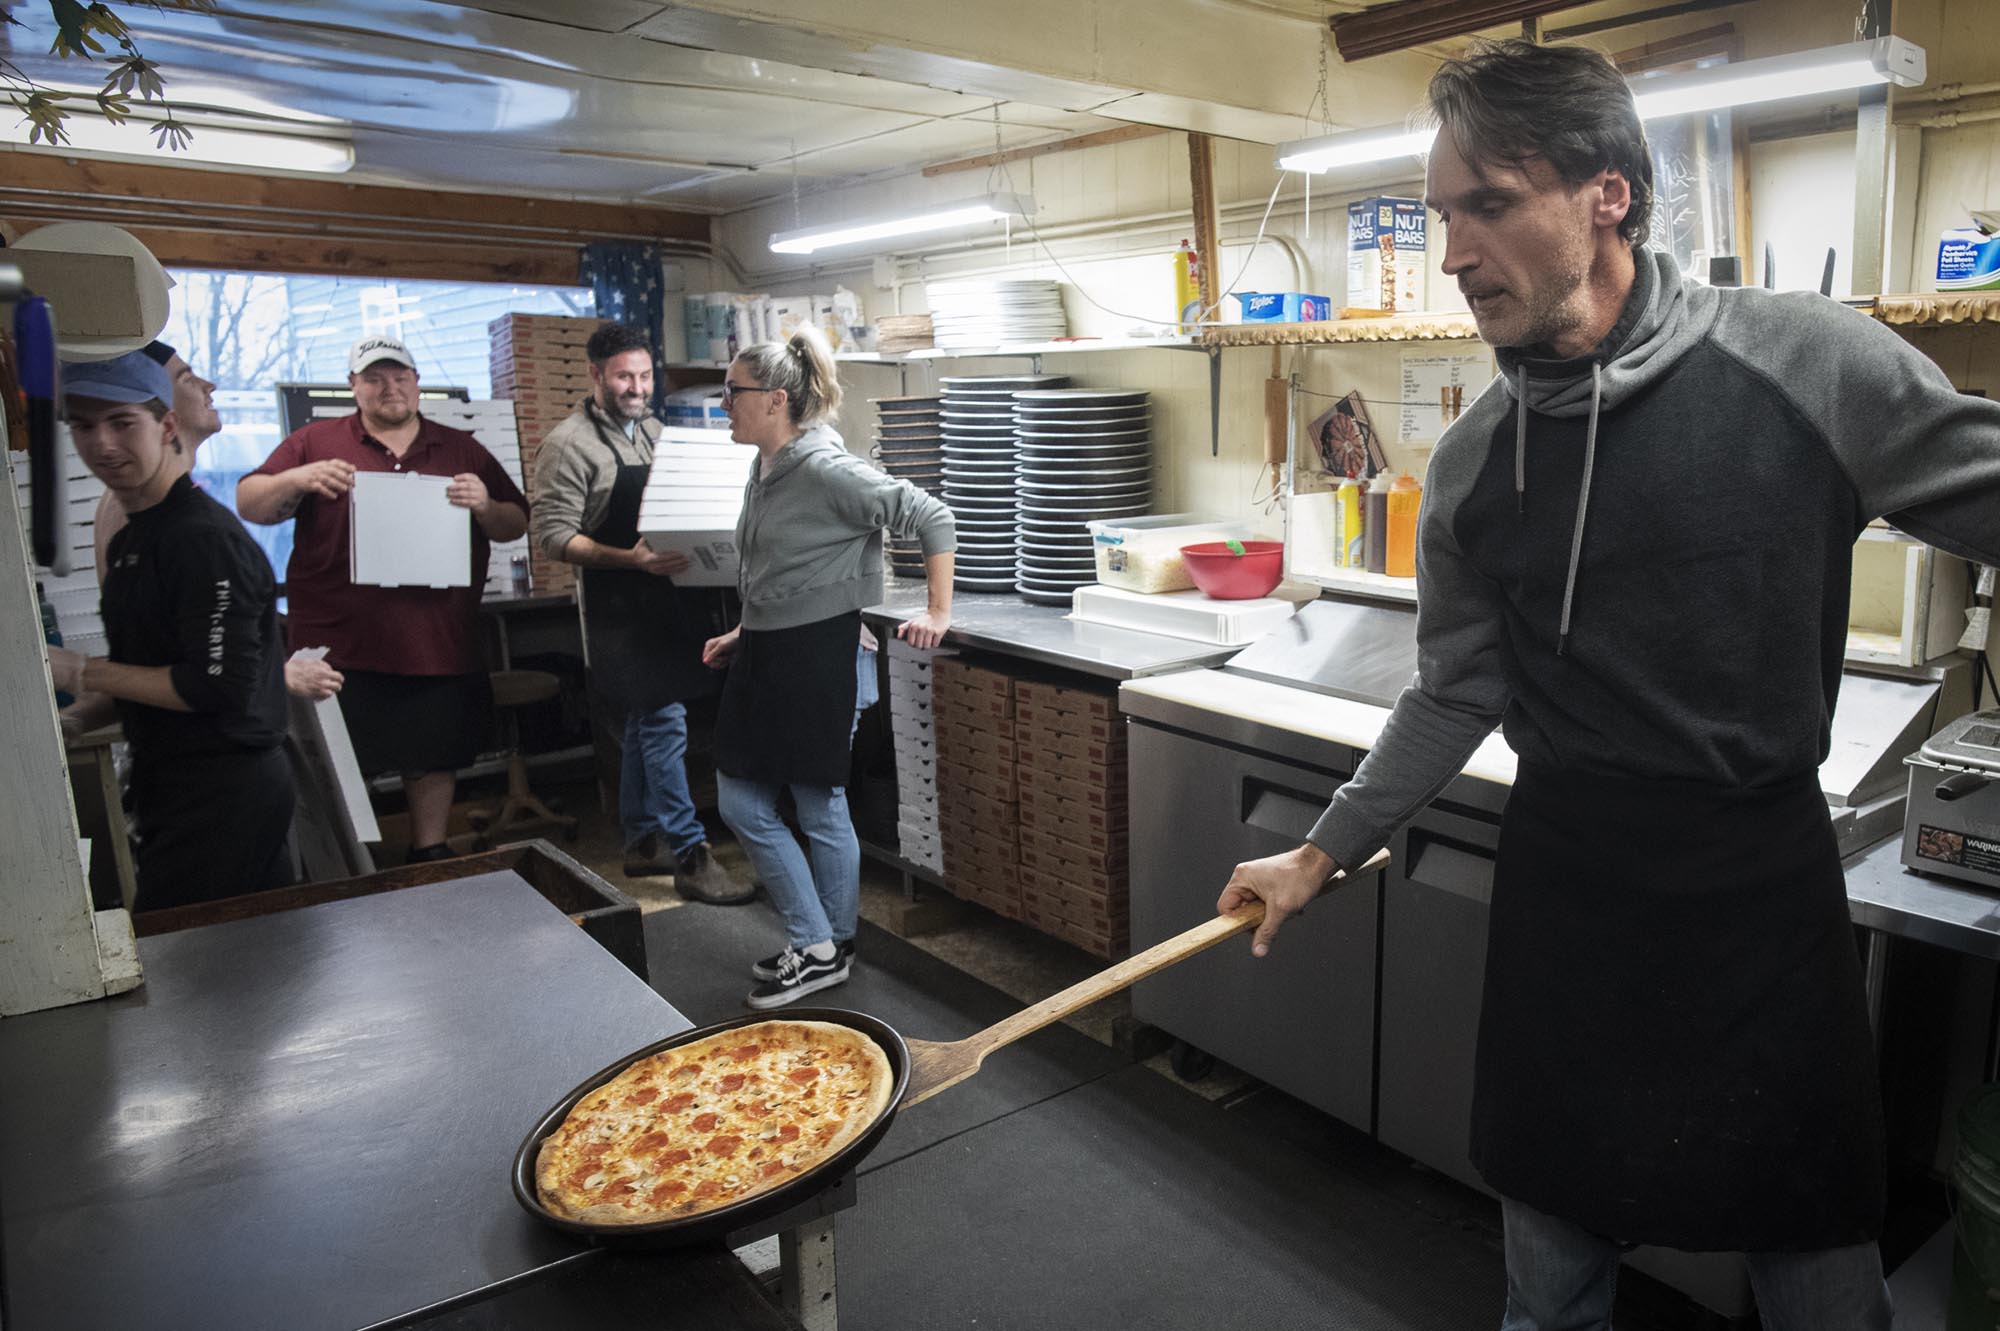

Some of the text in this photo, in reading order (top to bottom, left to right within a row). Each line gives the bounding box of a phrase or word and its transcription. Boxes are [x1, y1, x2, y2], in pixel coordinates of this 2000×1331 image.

[1350, 212, 1374, 228] NUT
[1380, 208, 1391, 219] 30
[1395, 214, 1425, 231] NUT
[1350, 227, 1374, 241] BARS
[1395, 230, 1425, 245] BARS
[1967, 838, 2000, 853] WARING
